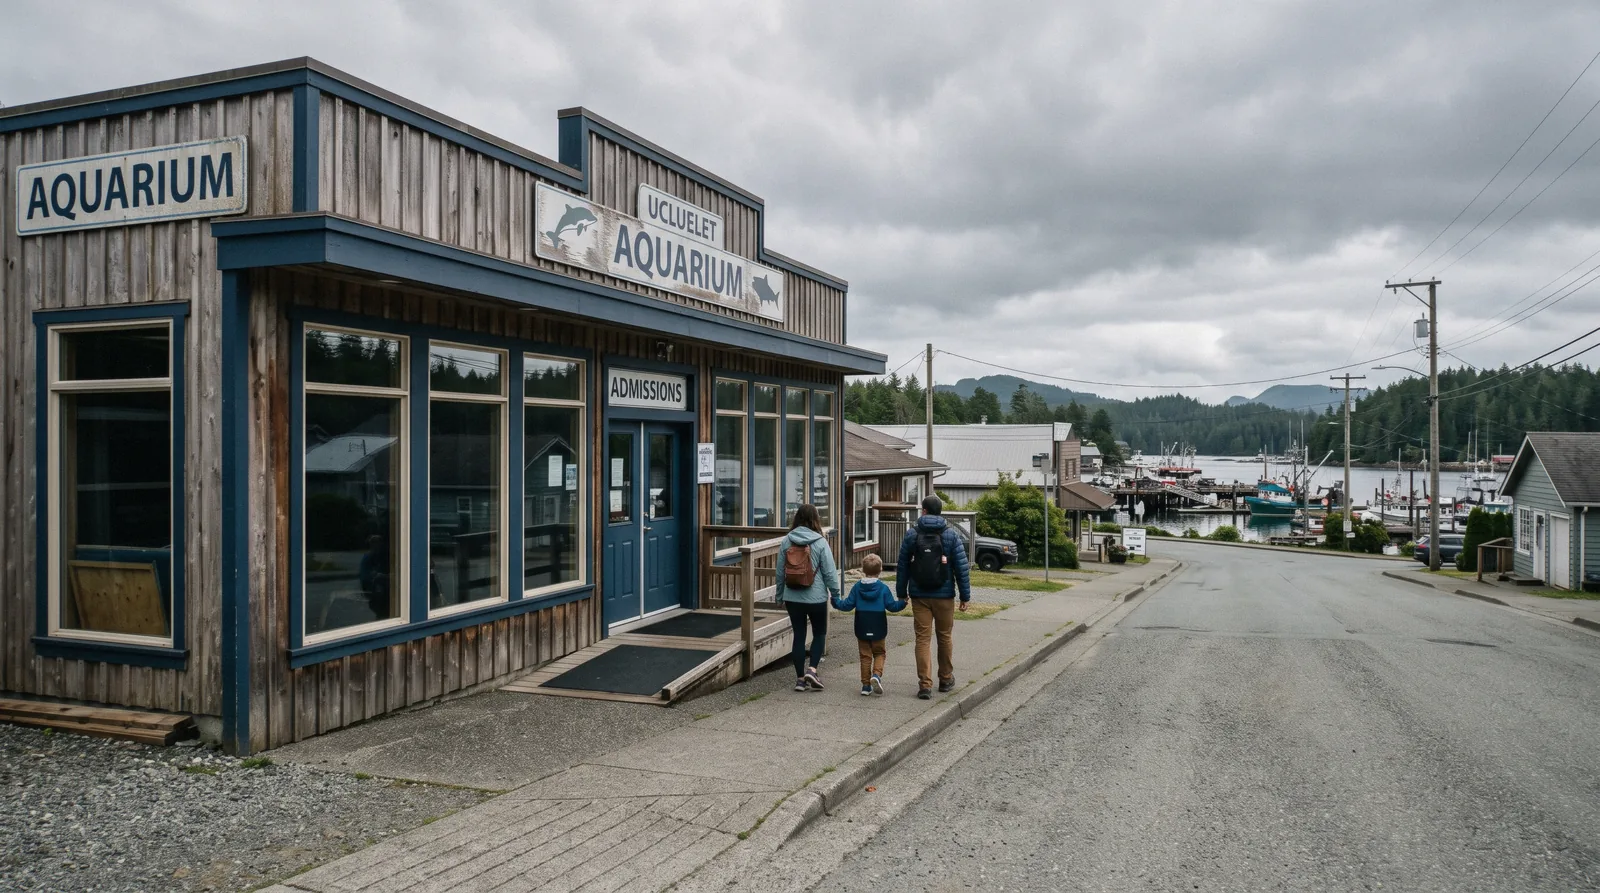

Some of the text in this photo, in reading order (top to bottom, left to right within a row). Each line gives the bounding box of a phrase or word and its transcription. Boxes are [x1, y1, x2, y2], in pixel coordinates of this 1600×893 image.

[27, 152, 234, 220] AQUARIUM
[648, 195, 717, 242] UCLUELET
[613, 224, 743, 299] AQUARIUM
[611, 376, 682, 403] ADMISSIONS
